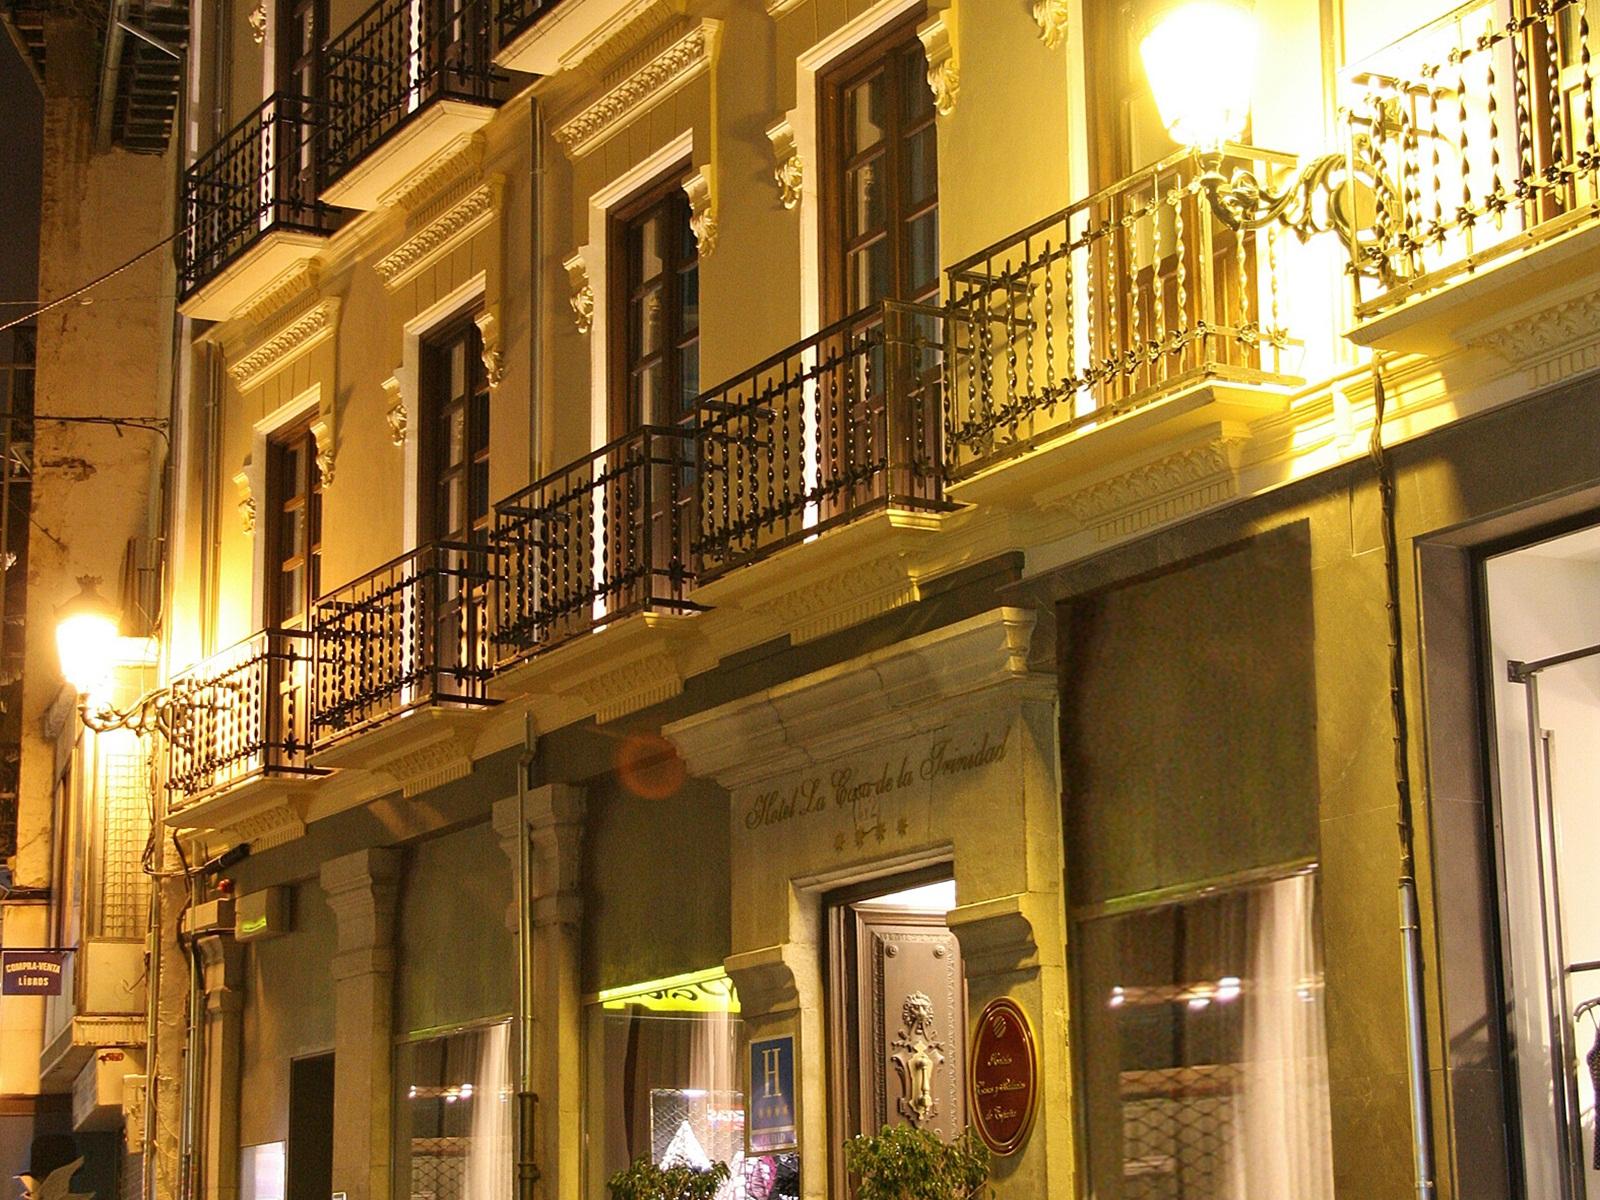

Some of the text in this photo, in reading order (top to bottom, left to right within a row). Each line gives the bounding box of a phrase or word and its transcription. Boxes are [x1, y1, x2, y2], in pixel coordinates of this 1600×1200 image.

[746, 725, 1012, 830] Hotel La Casa de la Trinidad
[5, 962, 61, 973] COMPRA-VENTA
[761, 1048, 782, 1099] H
